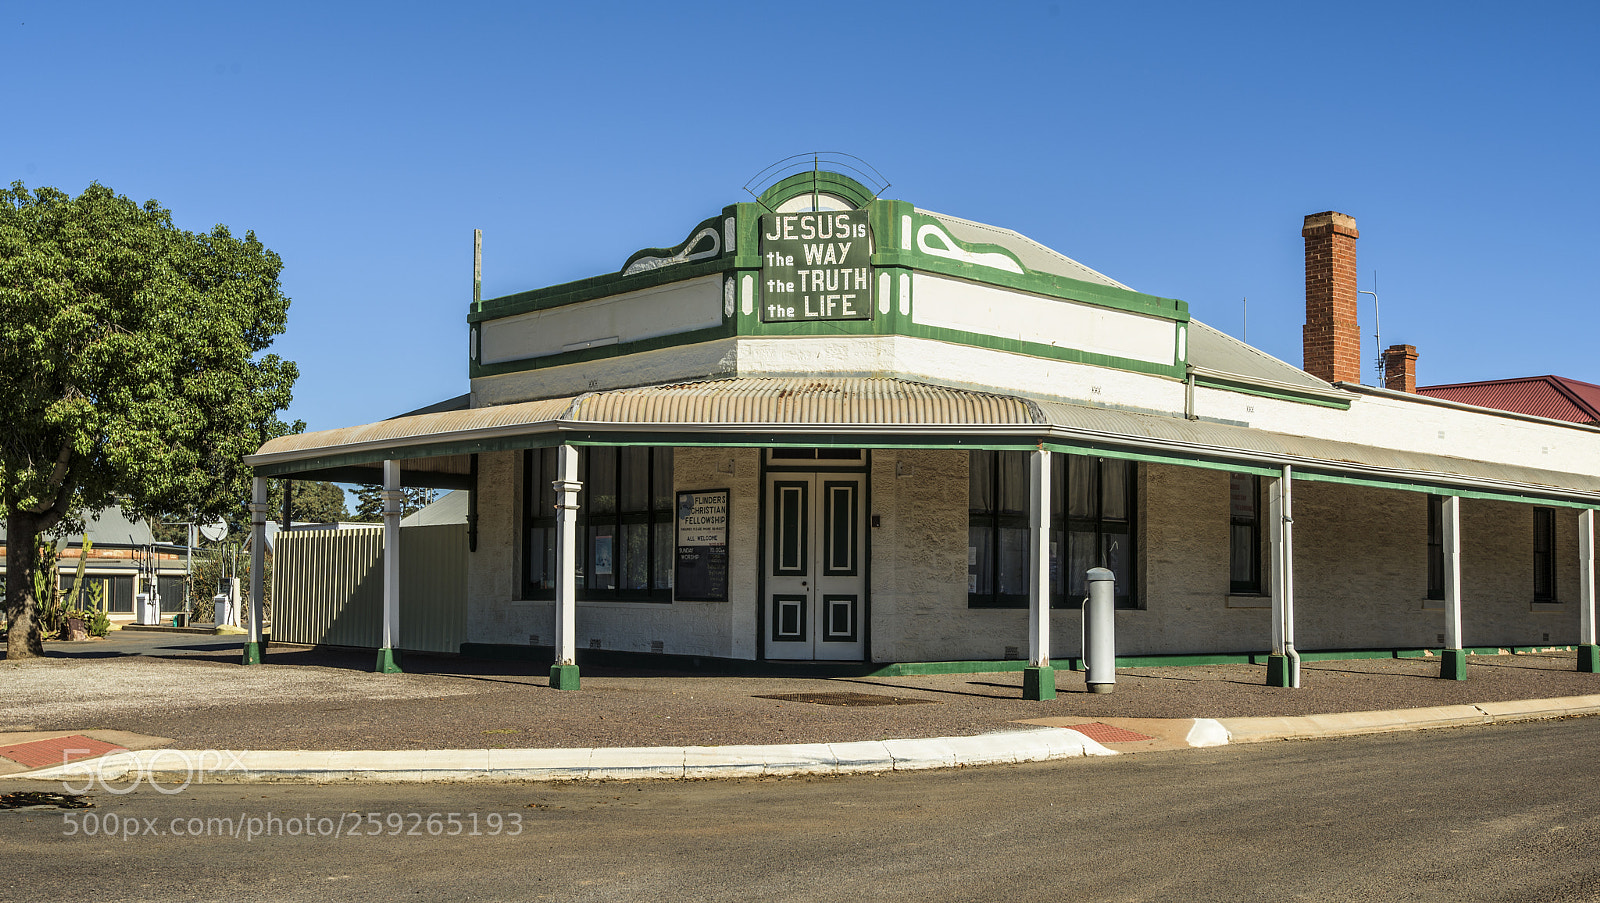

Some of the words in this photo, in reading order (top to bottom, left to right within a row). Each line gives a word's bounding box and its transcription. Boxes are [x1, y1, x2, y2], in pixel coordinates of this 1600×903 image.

[766, 215, 851, 241] JESUS
[767, 251, 794, 267] the
[803, 242, 852, 266] WAY
[767, 279, 795, 293] the
[797, 268, 867, 292] TRUTH
[768, 304, 795, 318] the
[804, 294, 857, 317] LIFE
[690, 506, 726, 515] CHRISTIAN
[694, 495, 726, 505] FLINDERS
[684, 516, 726, 525] FELLOWSHIP
